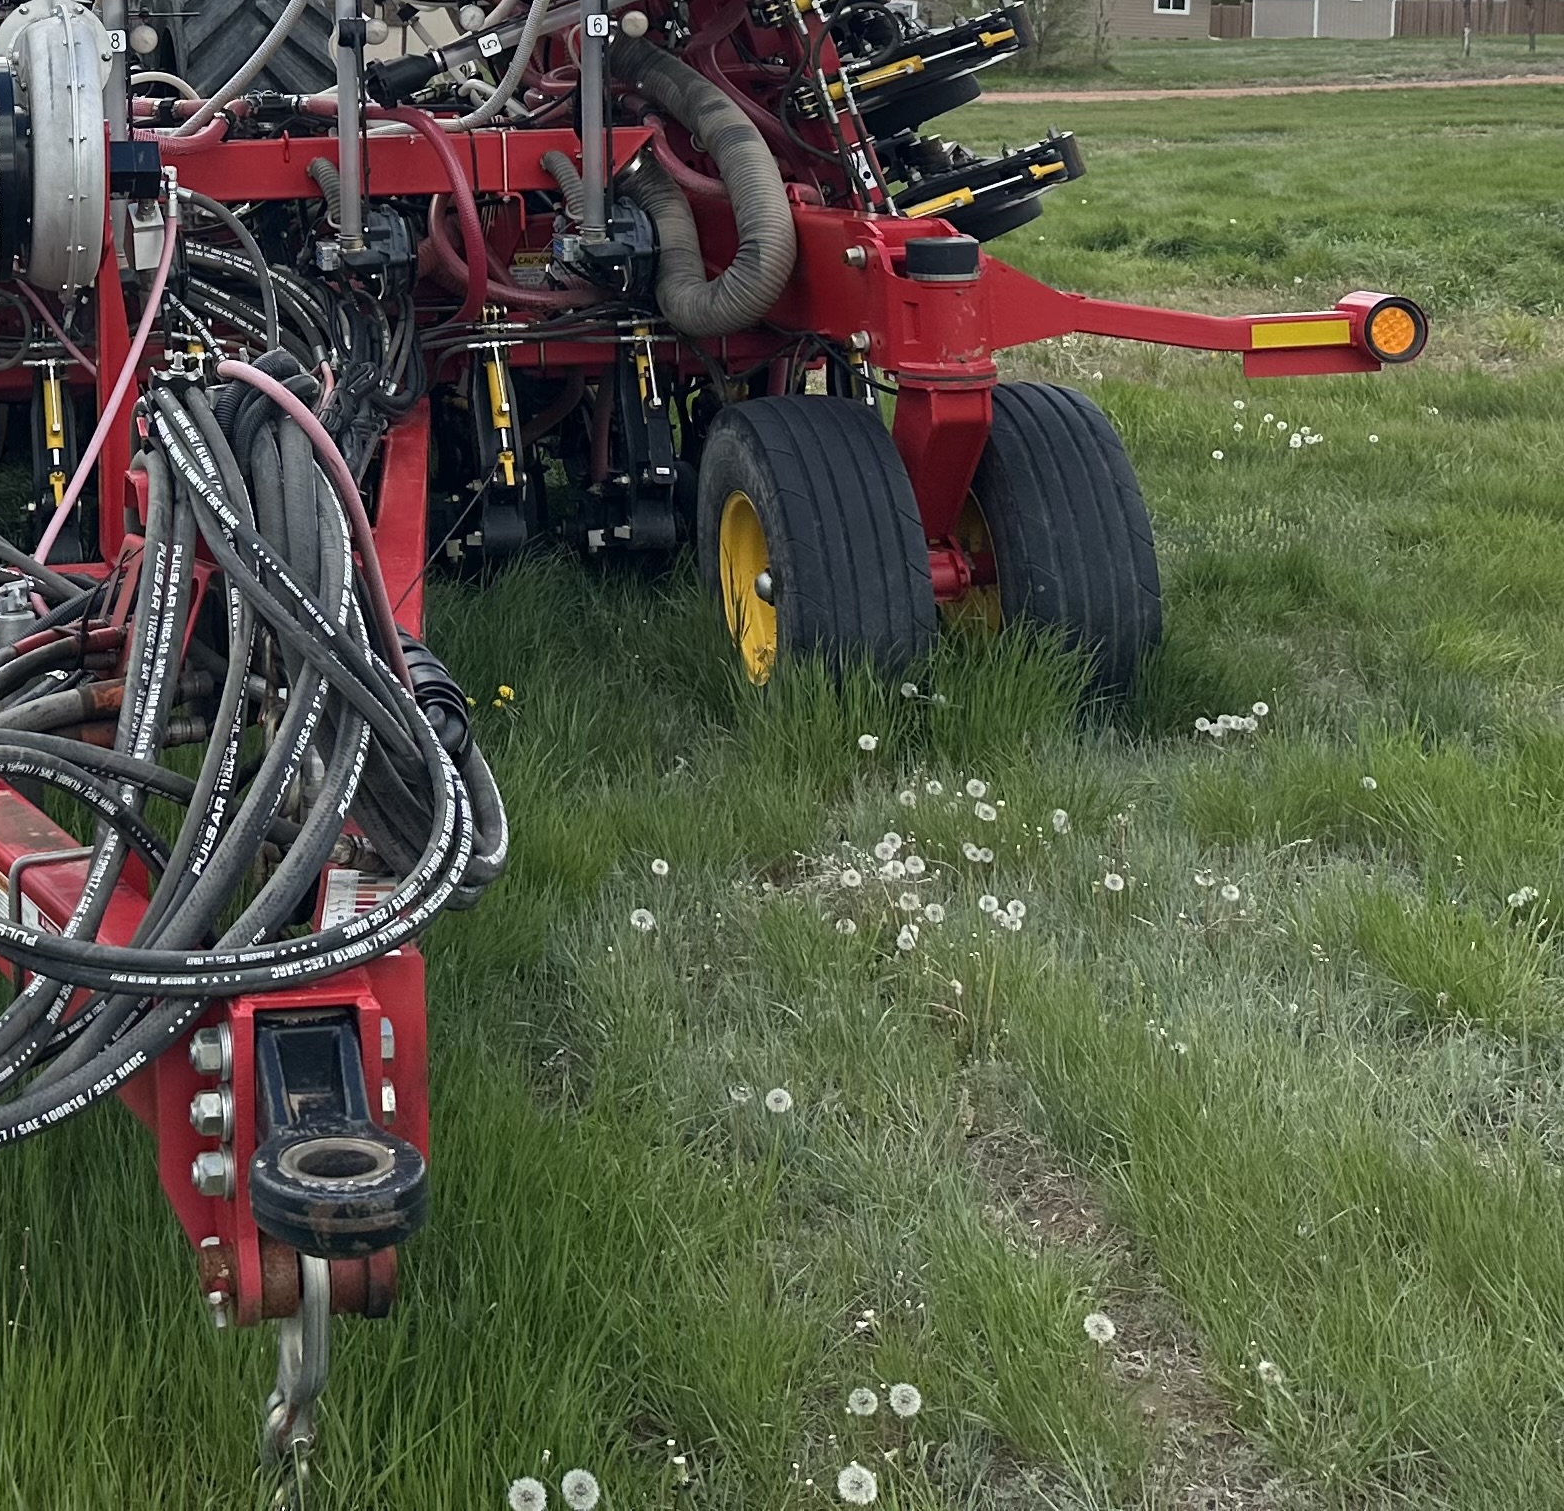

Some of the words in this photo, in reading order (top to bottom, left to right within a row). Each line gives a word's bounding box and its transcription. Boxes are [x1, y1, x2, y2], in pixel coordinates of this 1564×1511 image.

[593, 17, 603, 33] 6
[110, 32, 120, 50] 8
[482, 39, 498, 51] 5
[218, 506, 240, 530] HARC
[151, 541, 167, 611] PULSAR
[166, 544, 183, 608] PULSAR
[143, 707, 156, 725] PSI
[337, 751, 366, 820] PULSAR
[96, 796, 121, 818] HARC
[191, 796, 228, 877] PULSAR
[394, 885, 422, 913] 100R19
[341, 920, 371, 940] HARC
[369, 908, 390, 929] 2SC
[408, 909, 429, 931] SAE
[334, 940, 374, 964] 100R19
[270, 962, 300, 980] HARC
[45, 996, 66, 1025] HARC
[17, 1117, 42, 1137] SAE
[41, 1093, 88, 1125] 100R16
[92, 1073, 119, 1098] 2SC
[114, 1050, 149, 1081] HARC
